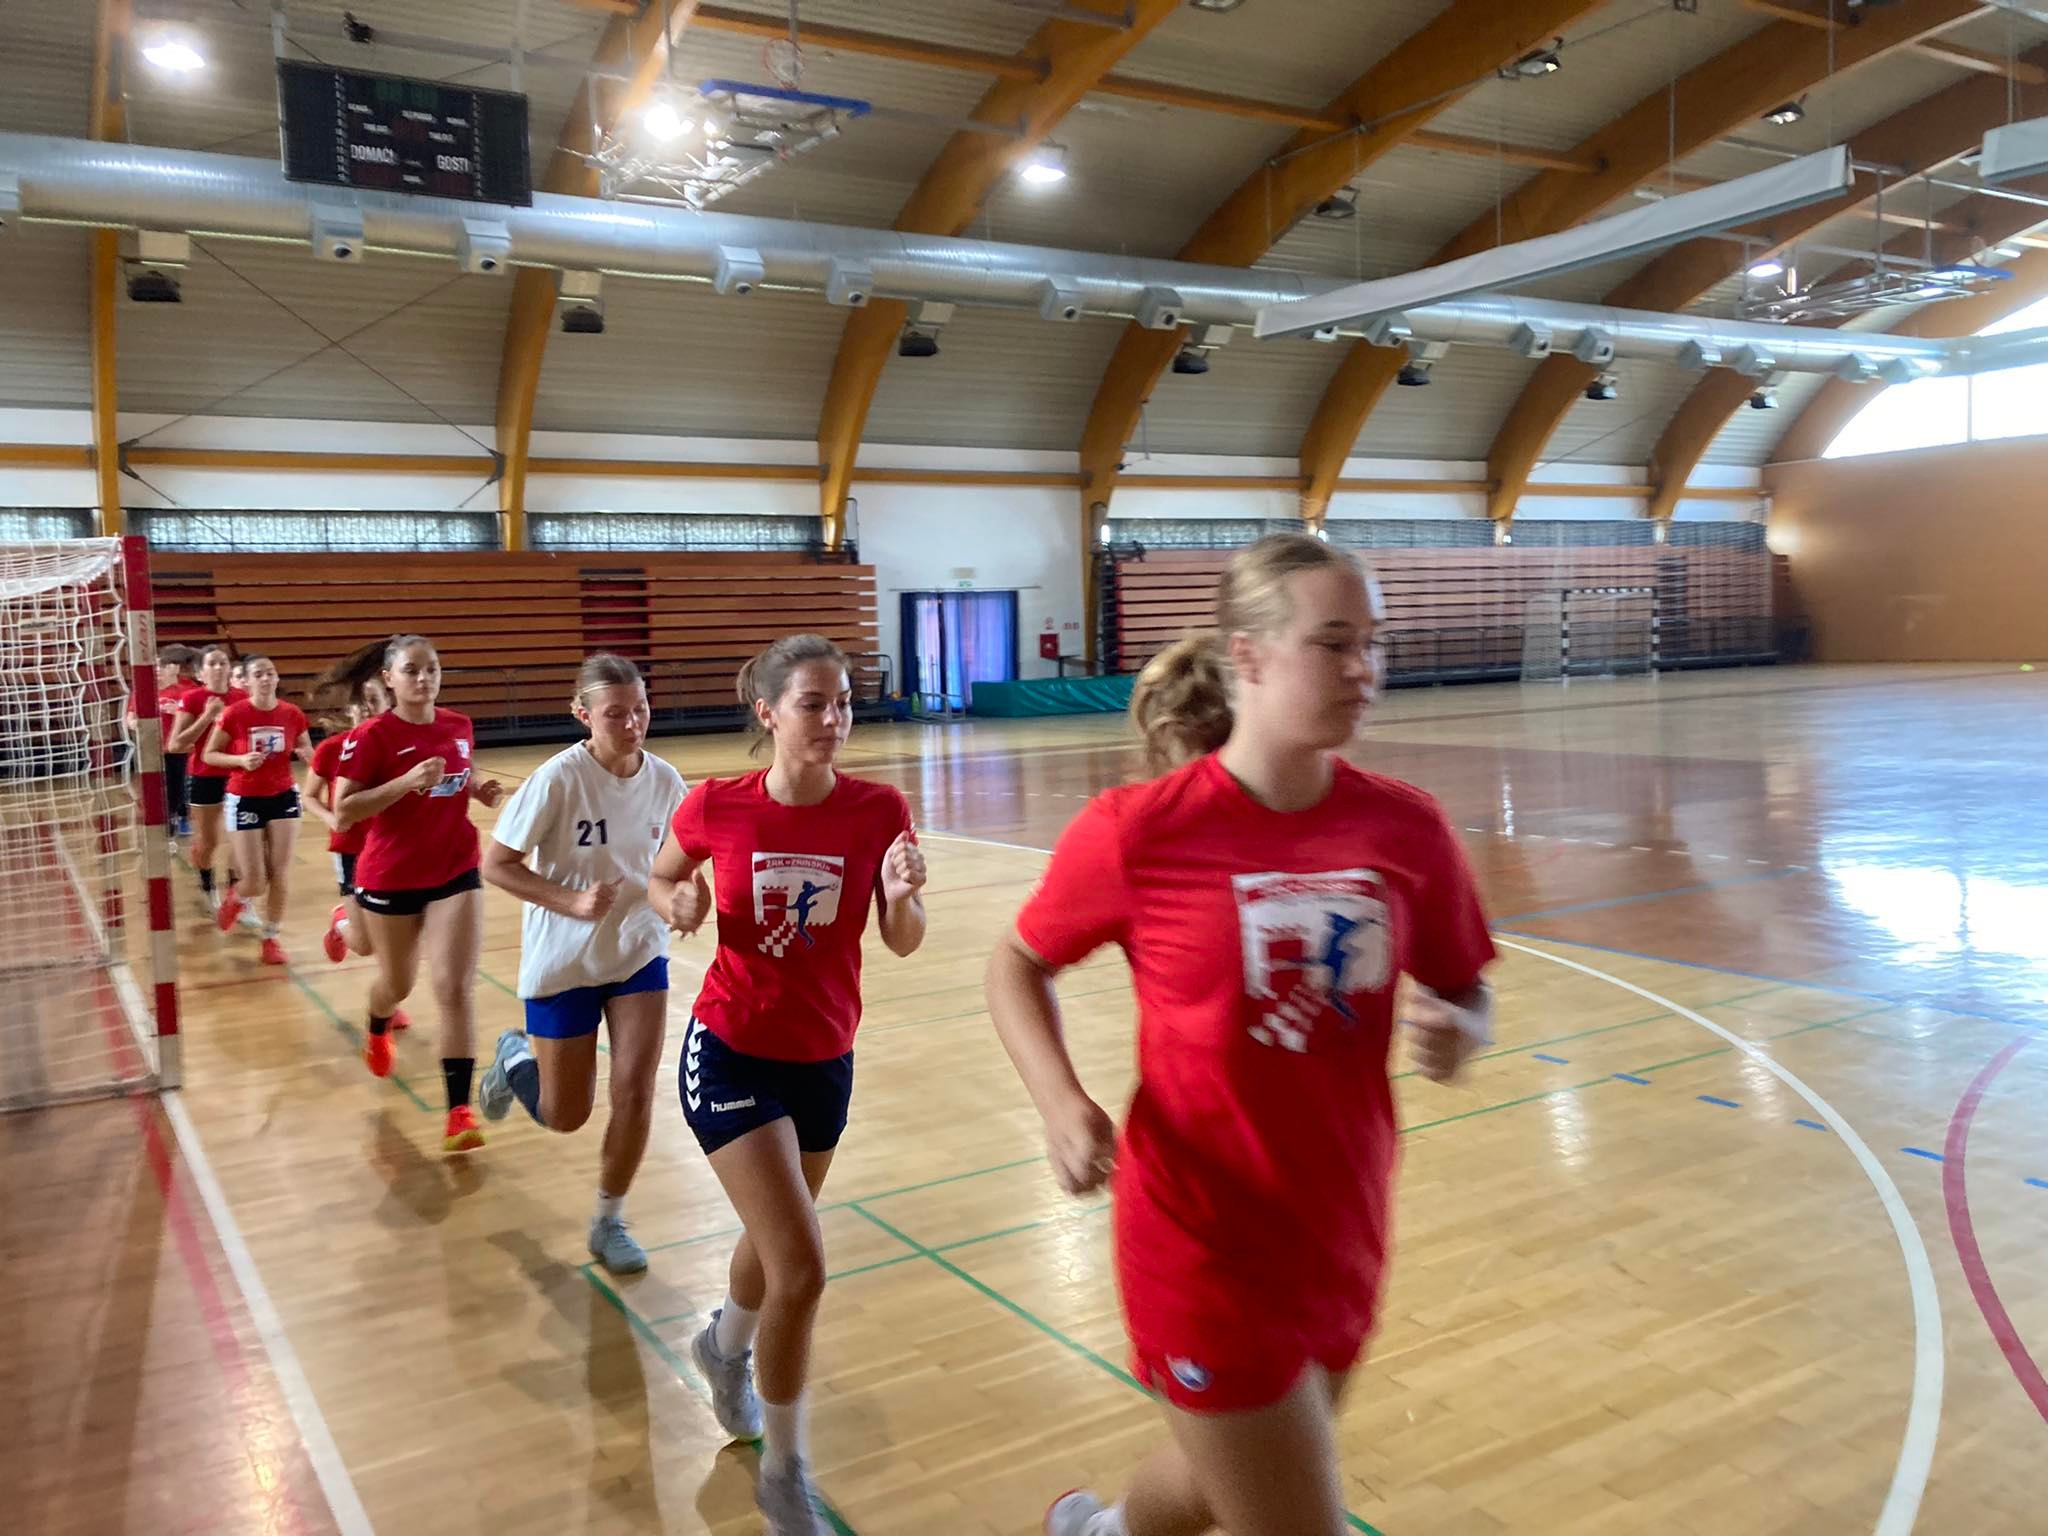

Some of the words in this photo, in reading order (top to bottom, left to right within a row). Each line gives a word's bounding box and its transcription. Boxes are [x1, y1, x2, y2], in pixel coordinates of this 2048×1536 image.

[437, 154, 469, 172] GOSTI
[577, 819, 608, 846] 21
[710, 1095, 756, 1113] hummel
